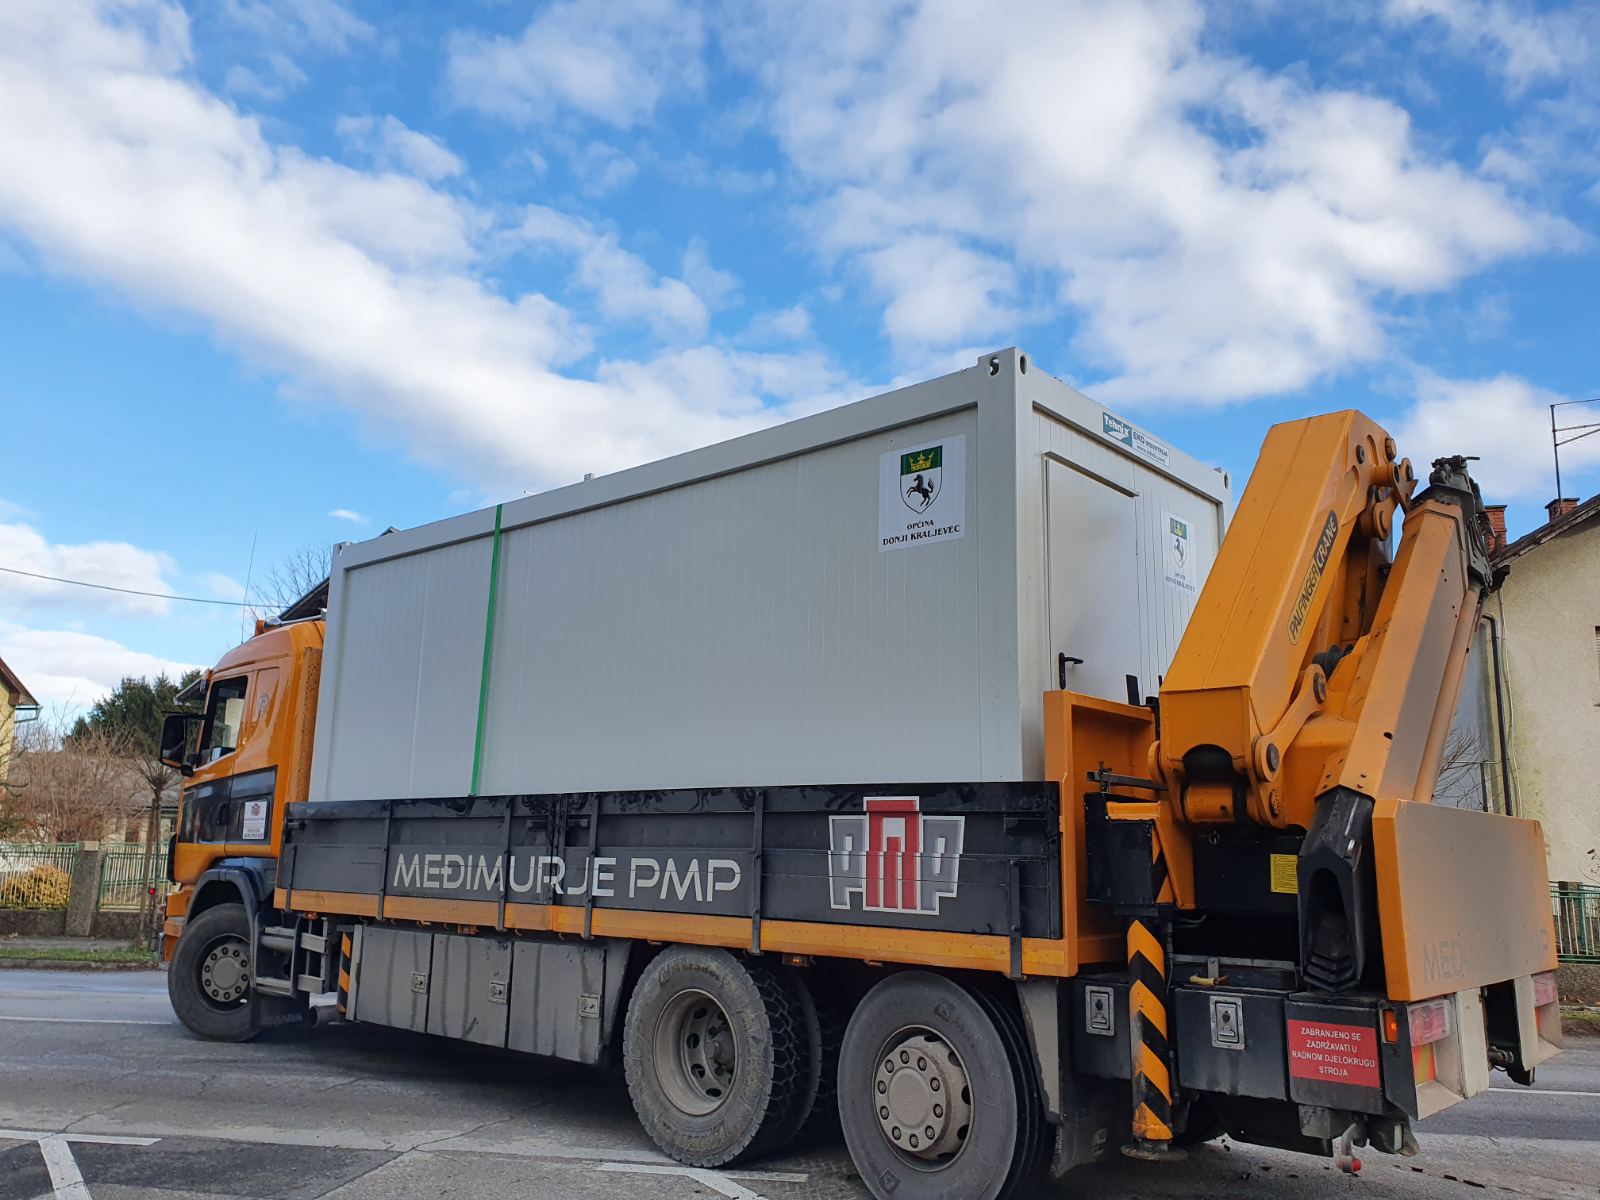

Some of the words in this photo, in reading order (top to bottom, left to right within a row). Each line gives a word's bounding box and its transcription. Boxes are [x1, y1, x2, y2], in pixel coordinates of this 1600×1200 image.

[1104, 414, 1129, 436] Tehnix
[907, 520, 934, 530] OPĆINA
[883, 535, 908, 545] DONJI
[910, 525, 960, 541] KRALJEVEC
[1289, 564, 1319, 640] PALFINGER
[1316, 516, 1337, 568] CRANE
[628, 857, 742, 902] PMP
[1301, 1027, 1349, 1039] ZABRANJENO
[1351, 1032, 1362, 1041] SE
[1306, 1040, 1350, 1051] ZADRŽAVATI
[1291, 1050, 1323, 1061] RADNOM
[1324, 1054, 1375, 1068] DJELOKRUGU
[1319, 1066, 1348, 1076] STROJA
